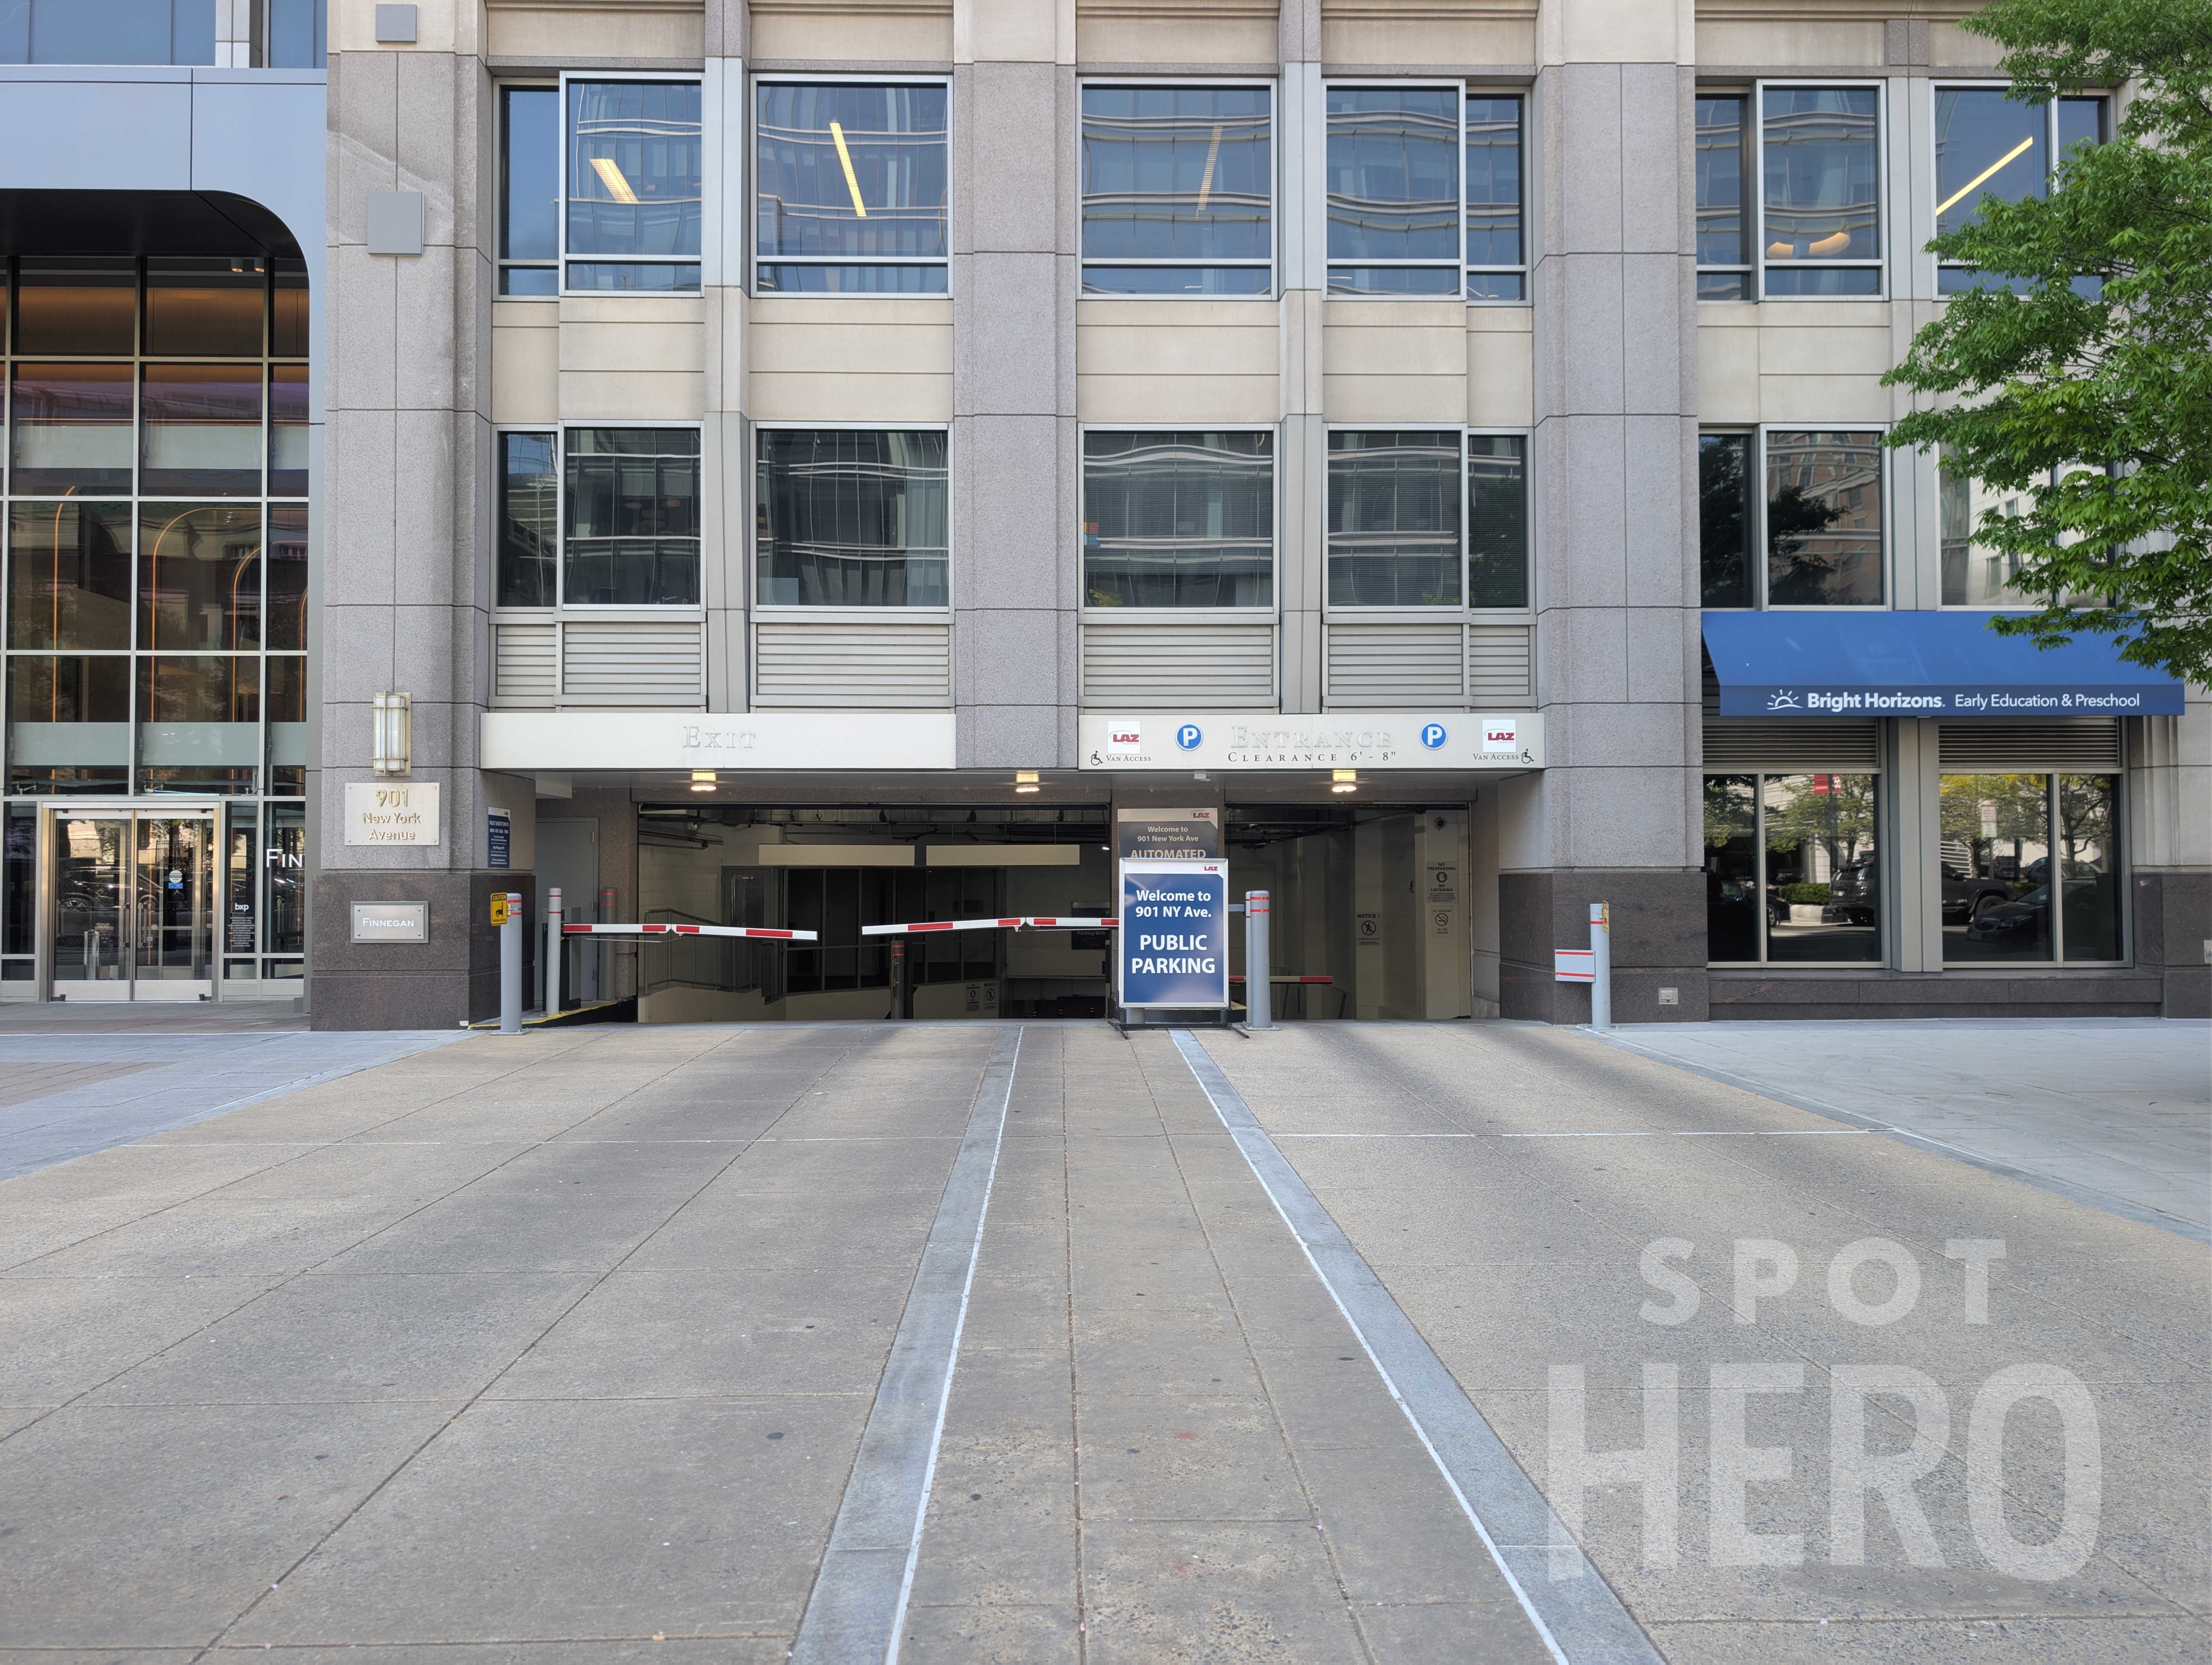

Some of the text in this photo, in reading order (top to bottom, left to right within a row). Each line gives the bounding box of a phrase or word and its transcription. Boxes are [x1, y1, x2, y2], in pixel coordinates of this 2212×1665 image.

[1808, 692, 1861, 712] Bright
[1955, 693, 1988, 710] Early
[1991, 693, 2058, 707] Education
[2061, 693, 2073, 707] &
[2075, 693, 2139, 707] Preschool
[683, 726, 756, 748] EXIT
[1113, 734, 1139, 742] LAZ
[1183, 728, 1197, 746] P
[1232, 726, 1391, 748] ENTRANCE
[1427, 727, 1442, 745] P
[1488, 733, 1514, 741] LAZ
[1228, 752, 1337, 761] CLEARANCE
[376, 789, 408, 806] 901
[363, 813, 421, 824] New York
[369, 829, 415, 840] Avenue
[1131, 849, 1206, 858] AUTOMATED
[1136, 890, 1211, 901] Welcome to
[235, 902, 249, 912] bxp
[1135, 907, 1211, 917] 901 NY Ave.
[363, 918, 414, 927] FINNEGAN
[1141, 935, 1207, 950] PUBLIC
[1132, 958, 1215, 973] PARKING
